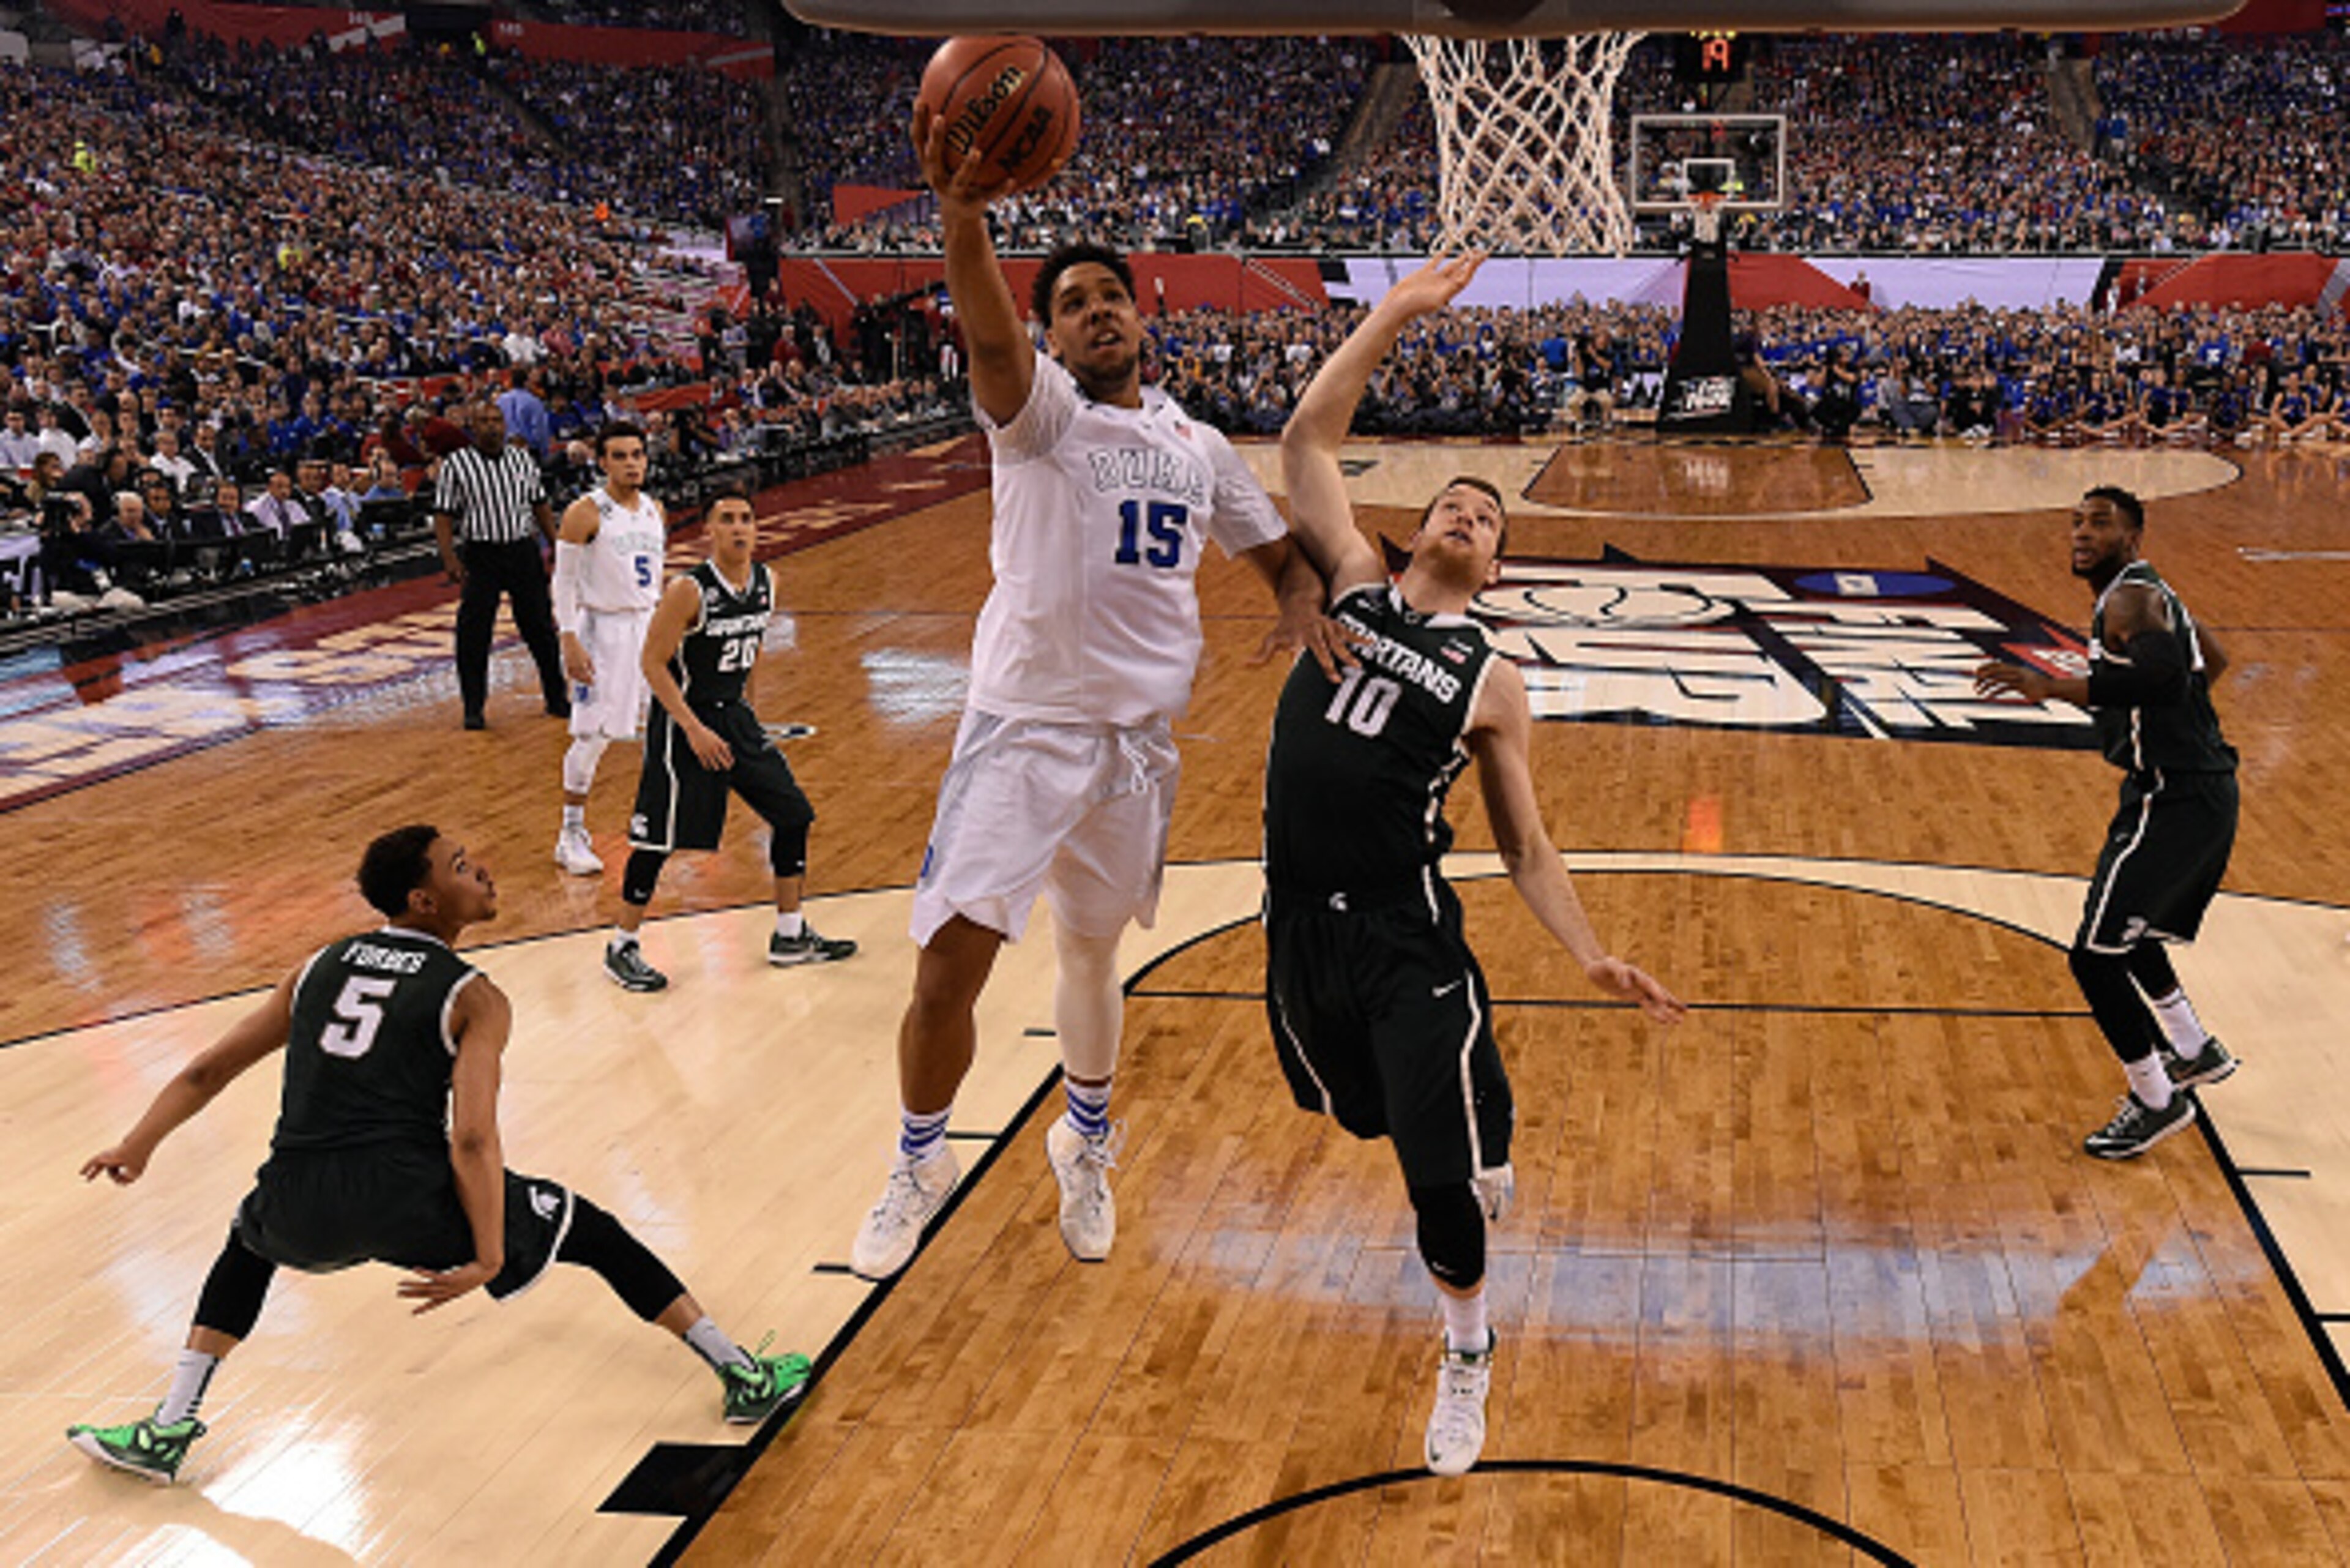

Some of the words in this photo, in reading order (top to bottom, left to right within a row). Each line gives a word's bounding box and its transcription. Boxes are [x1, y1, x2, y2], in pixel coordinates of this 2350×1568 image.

[1703, 38, 1729, 72] 19
[946, 65, 1026, 155] Wilson
[998, 105, 1053, 173] NCAA
[1087, 448, 1204, 507] DUKE
[1115, 499, 1188, 568] 15
[634, 555, 652, 588] 5
[1324, 666, 1401, 738] 10
[341, 941, 427, 973] FORBES
[318, 976, 397, 1058] 5
